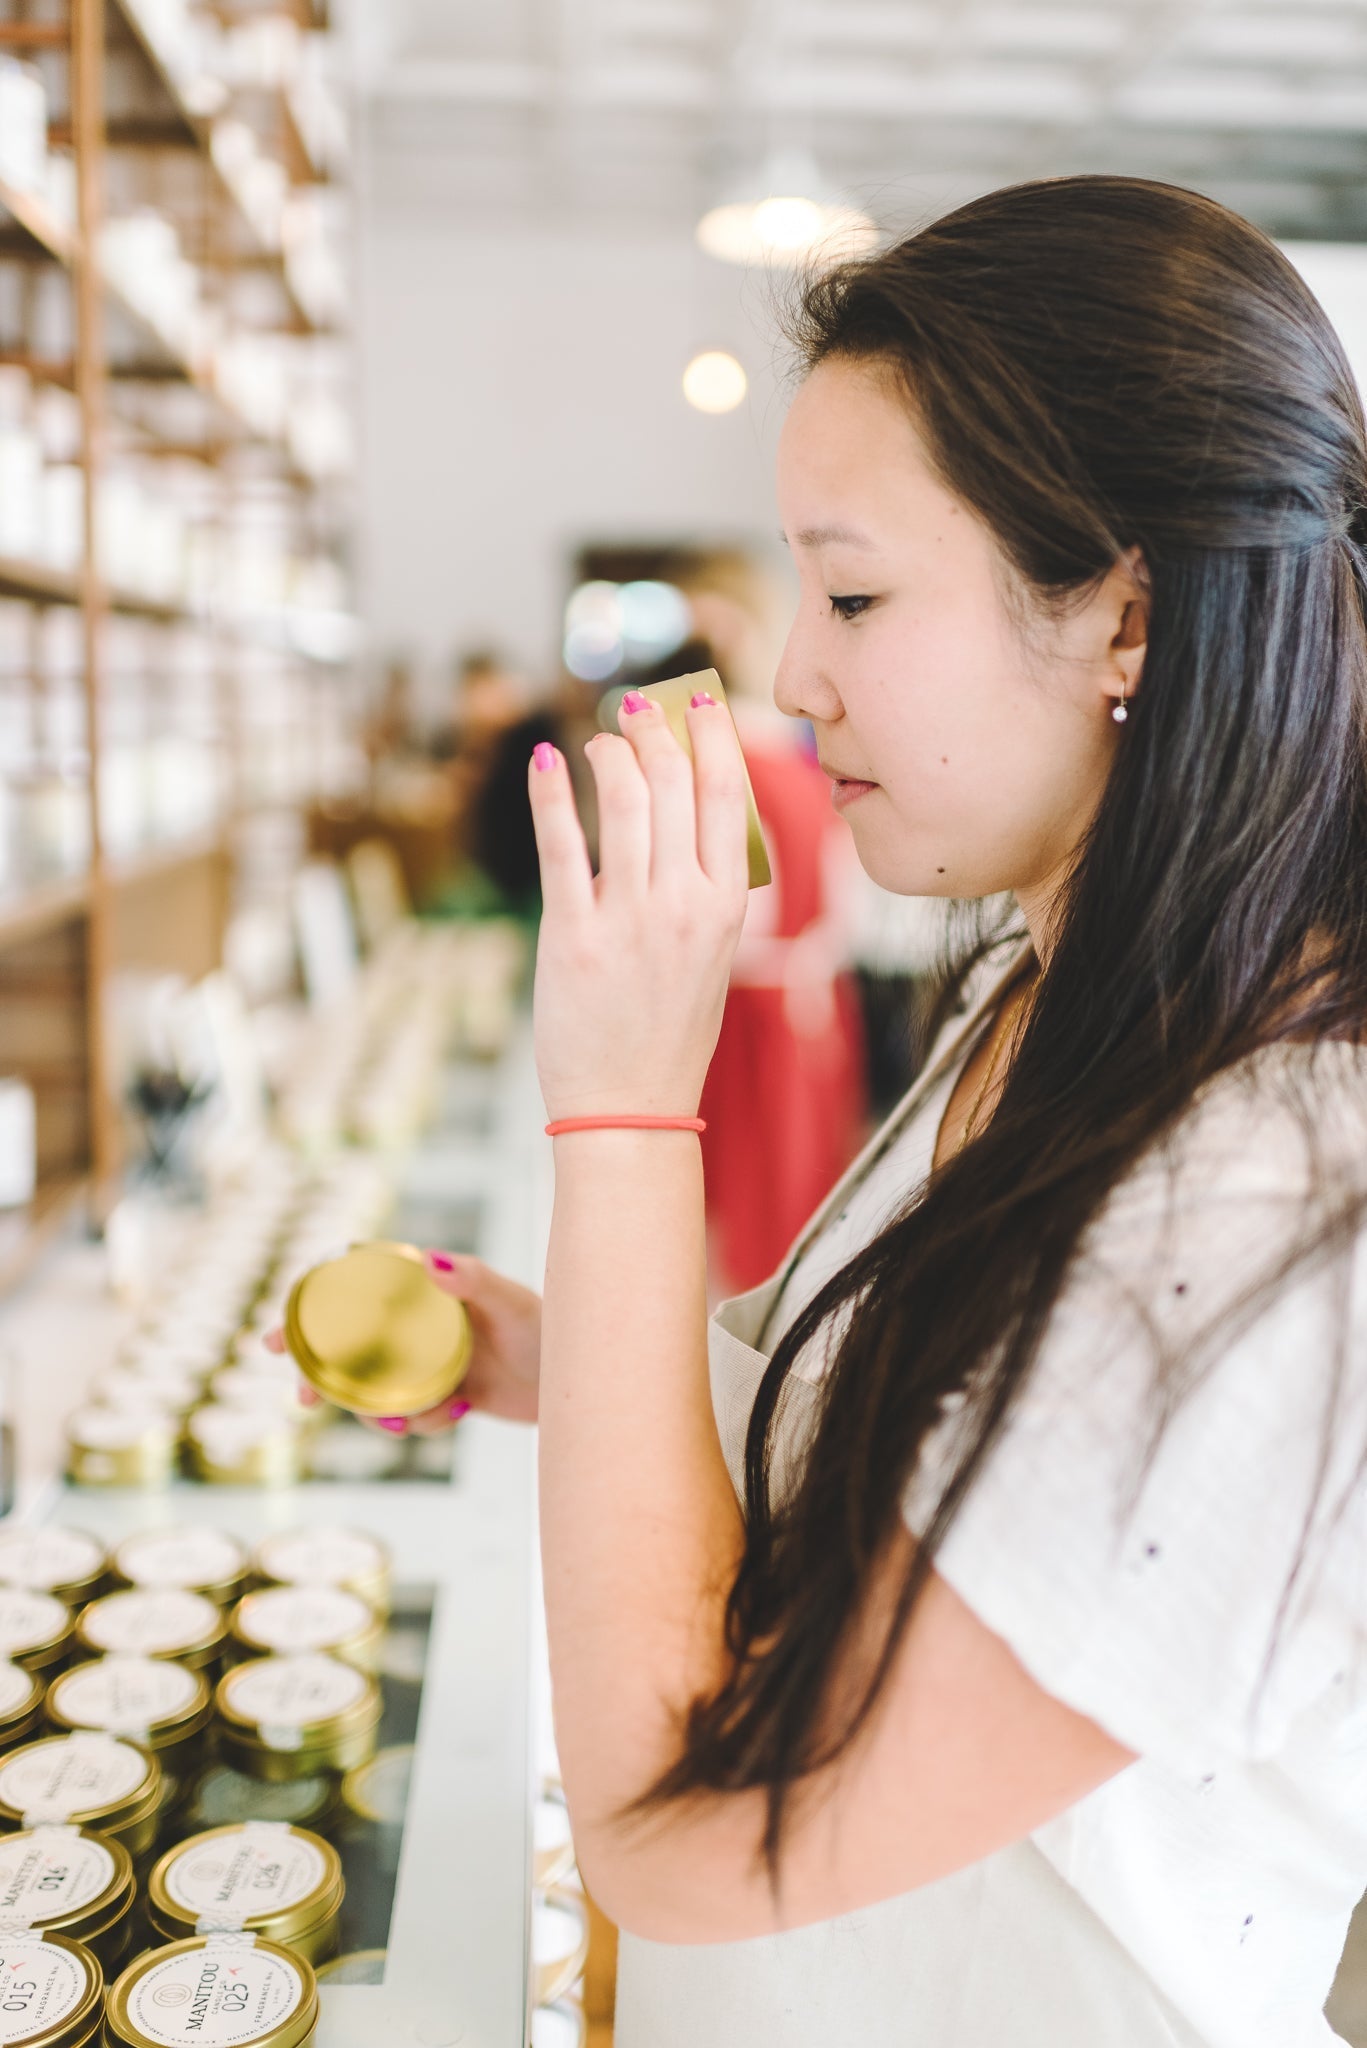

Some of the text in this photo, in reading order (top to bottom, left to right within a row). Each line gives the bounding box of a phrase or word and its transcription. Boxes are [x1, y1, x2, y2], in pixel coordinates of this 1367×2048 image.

[3, 1982, 36, 2010] 015
[35, 1978, 55, 2019] FRAGRANCE
[185, 1963, 219, 2030] MANITOU
[222, 1984, 249, 2011] 025
[254, 1984, 271, 2023] FRAGRANCE
